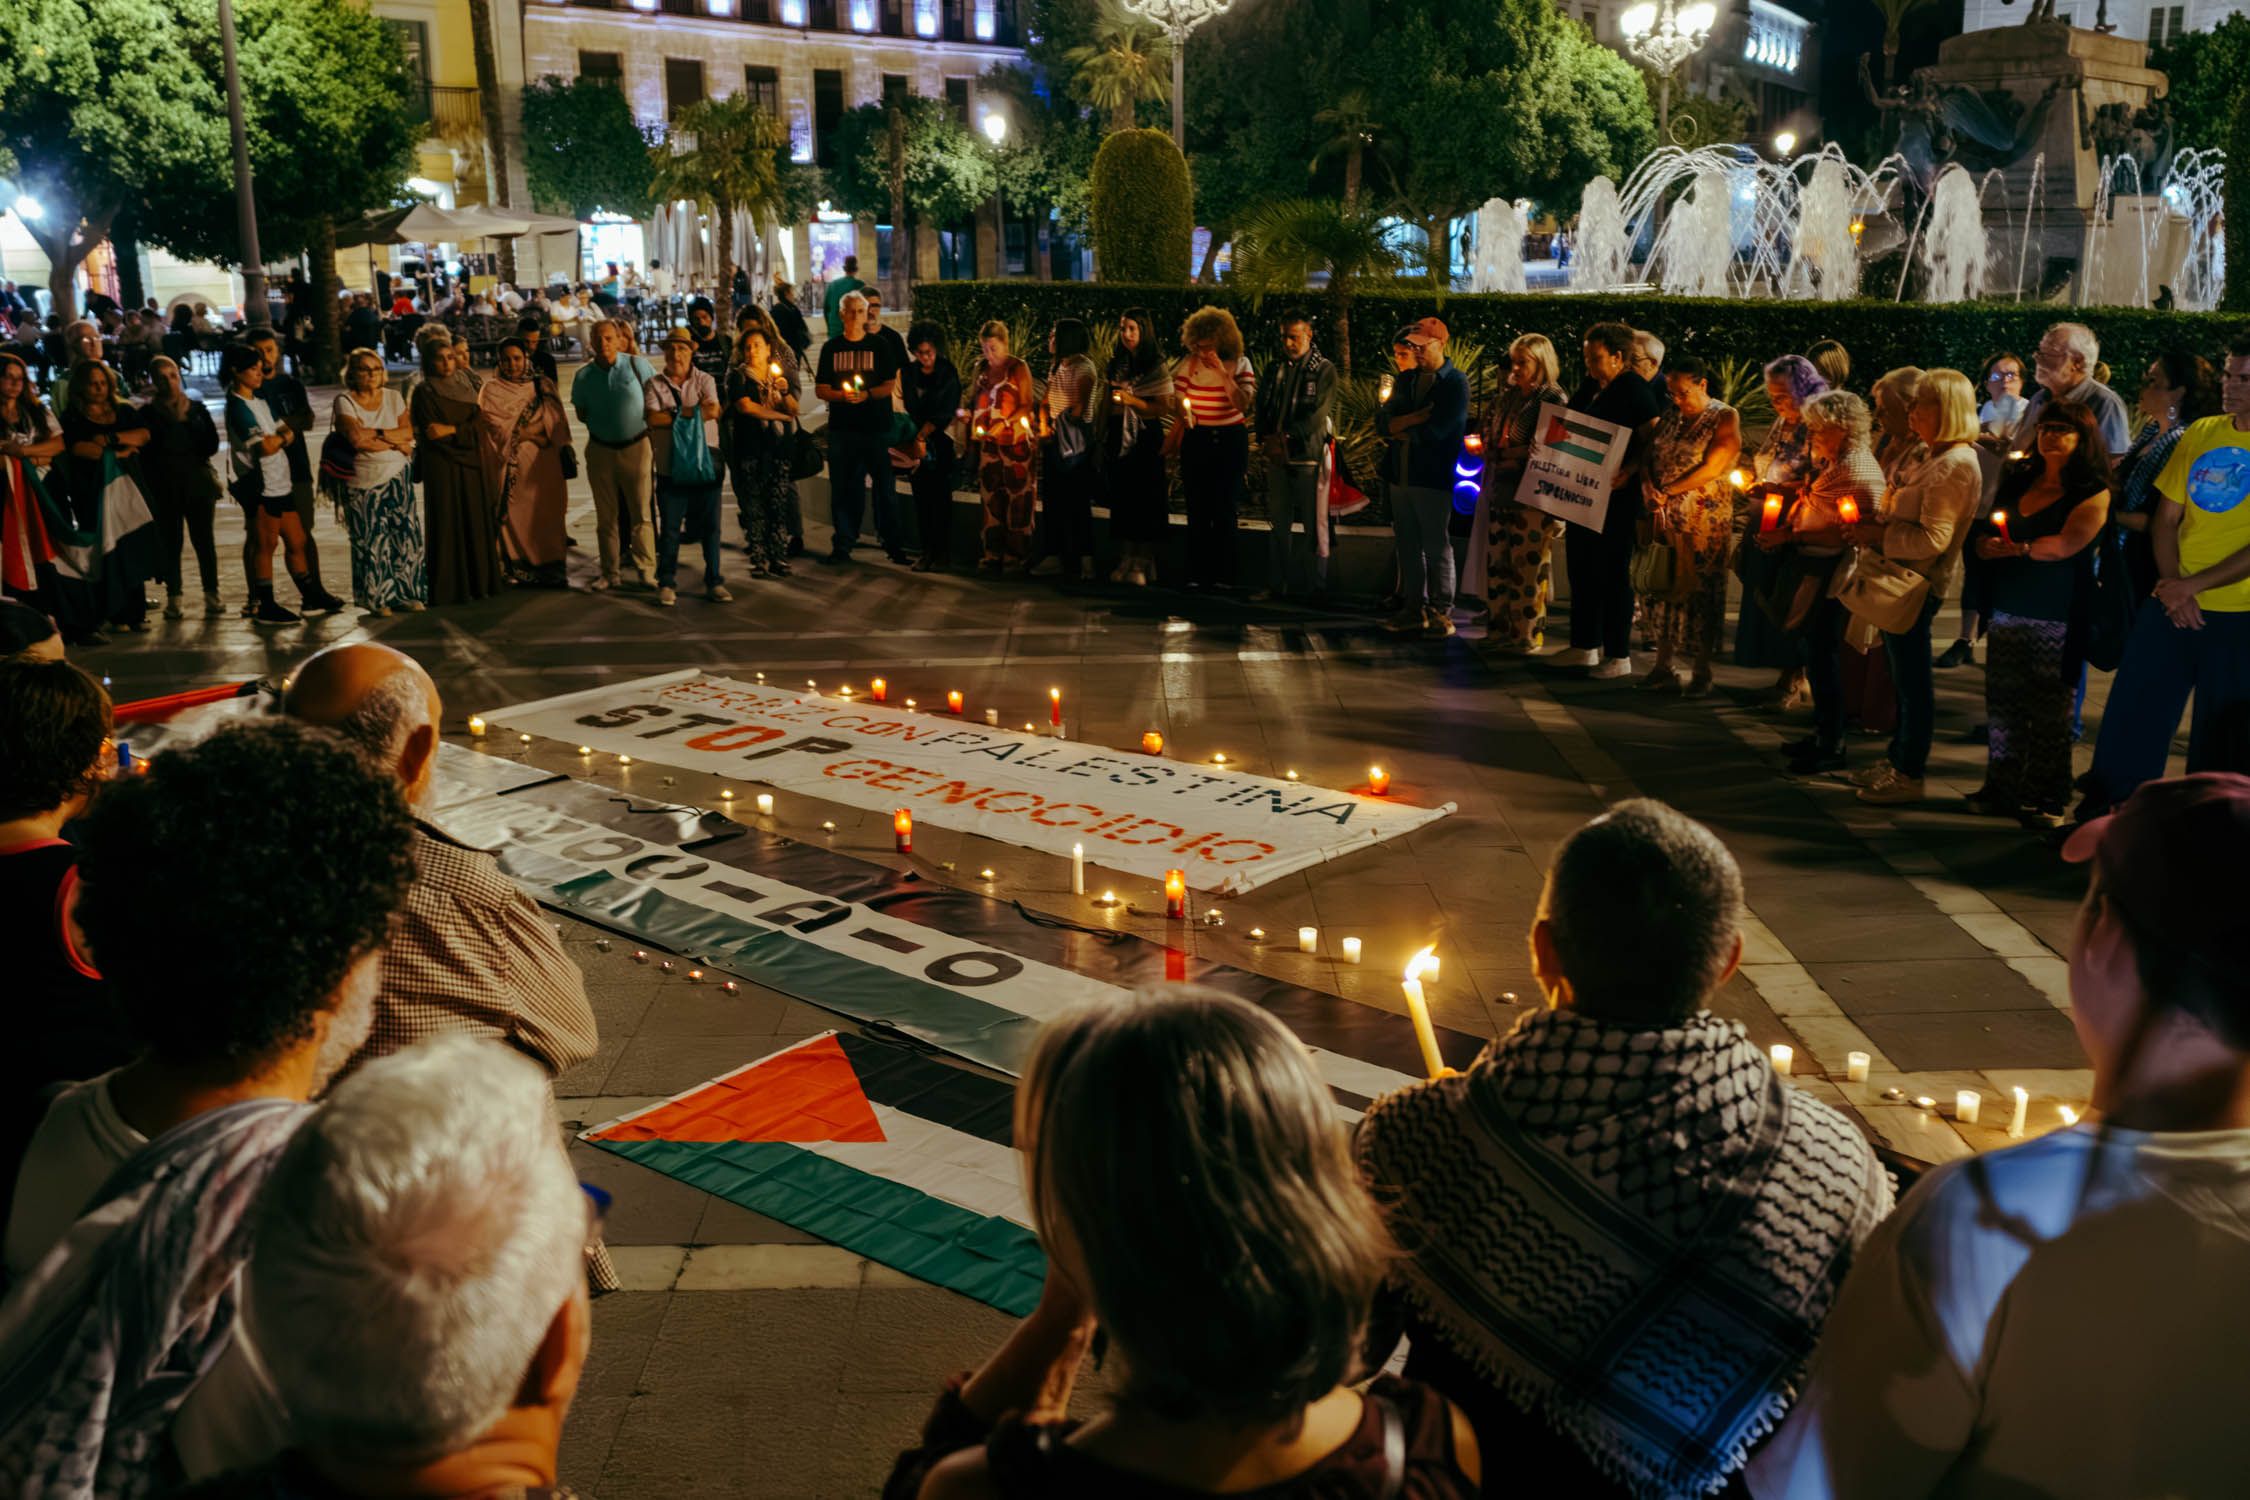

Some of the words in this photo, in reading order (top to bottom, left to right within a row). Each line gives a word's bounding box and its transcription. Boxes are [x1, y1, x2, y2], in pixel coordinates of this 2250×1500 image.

[1575, 473, 1600, 489] LIBRE
[573, 704, 854, 761] STOP
[823, 759, 1276, 864] GENOCIDIO
[822, 716, 939, 743] CON
[920, 731, 1356, 825] PALESTINA
